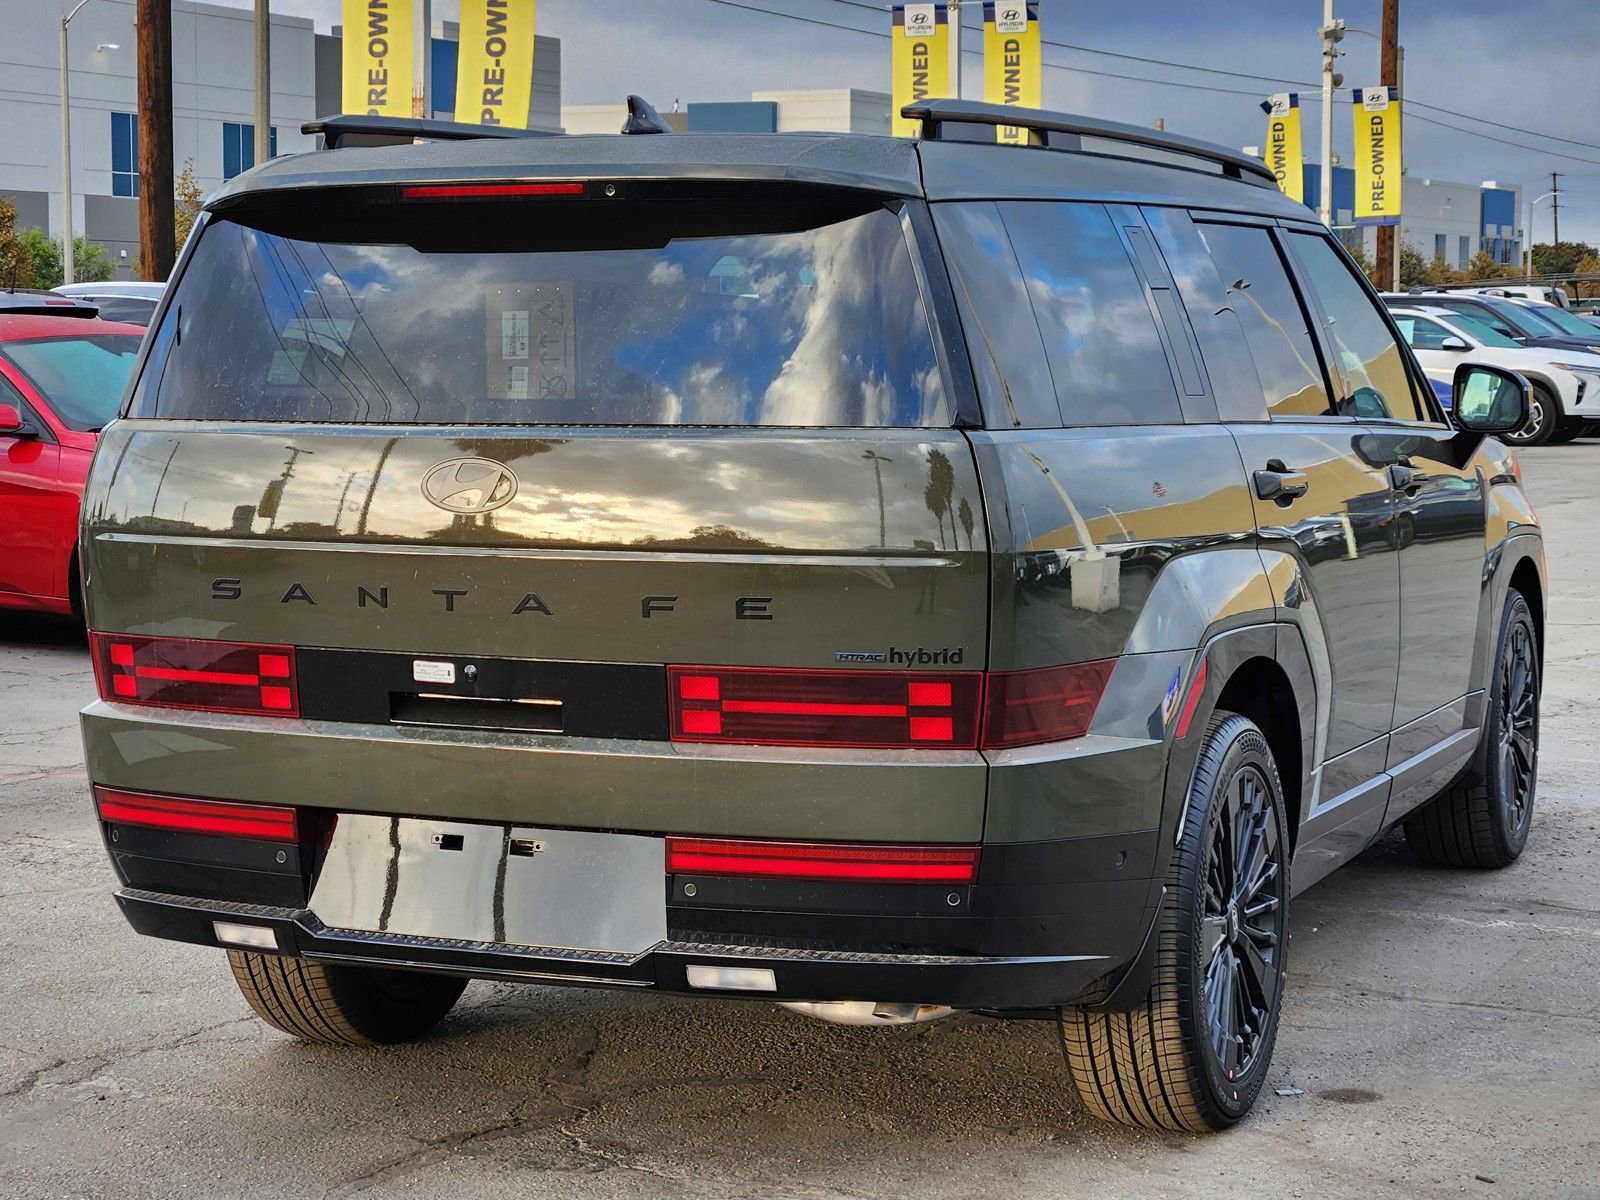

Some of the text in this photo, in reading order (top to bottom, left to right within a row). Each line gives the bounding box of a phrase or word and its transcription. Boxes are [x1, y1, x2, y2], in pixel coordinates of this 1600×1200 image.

[1371, 115, 1384, 211] PRE-OWNED
[212, 577, 774, 620] SANTA FE
[838, 647, 963, 667] HTRAC hybrid
